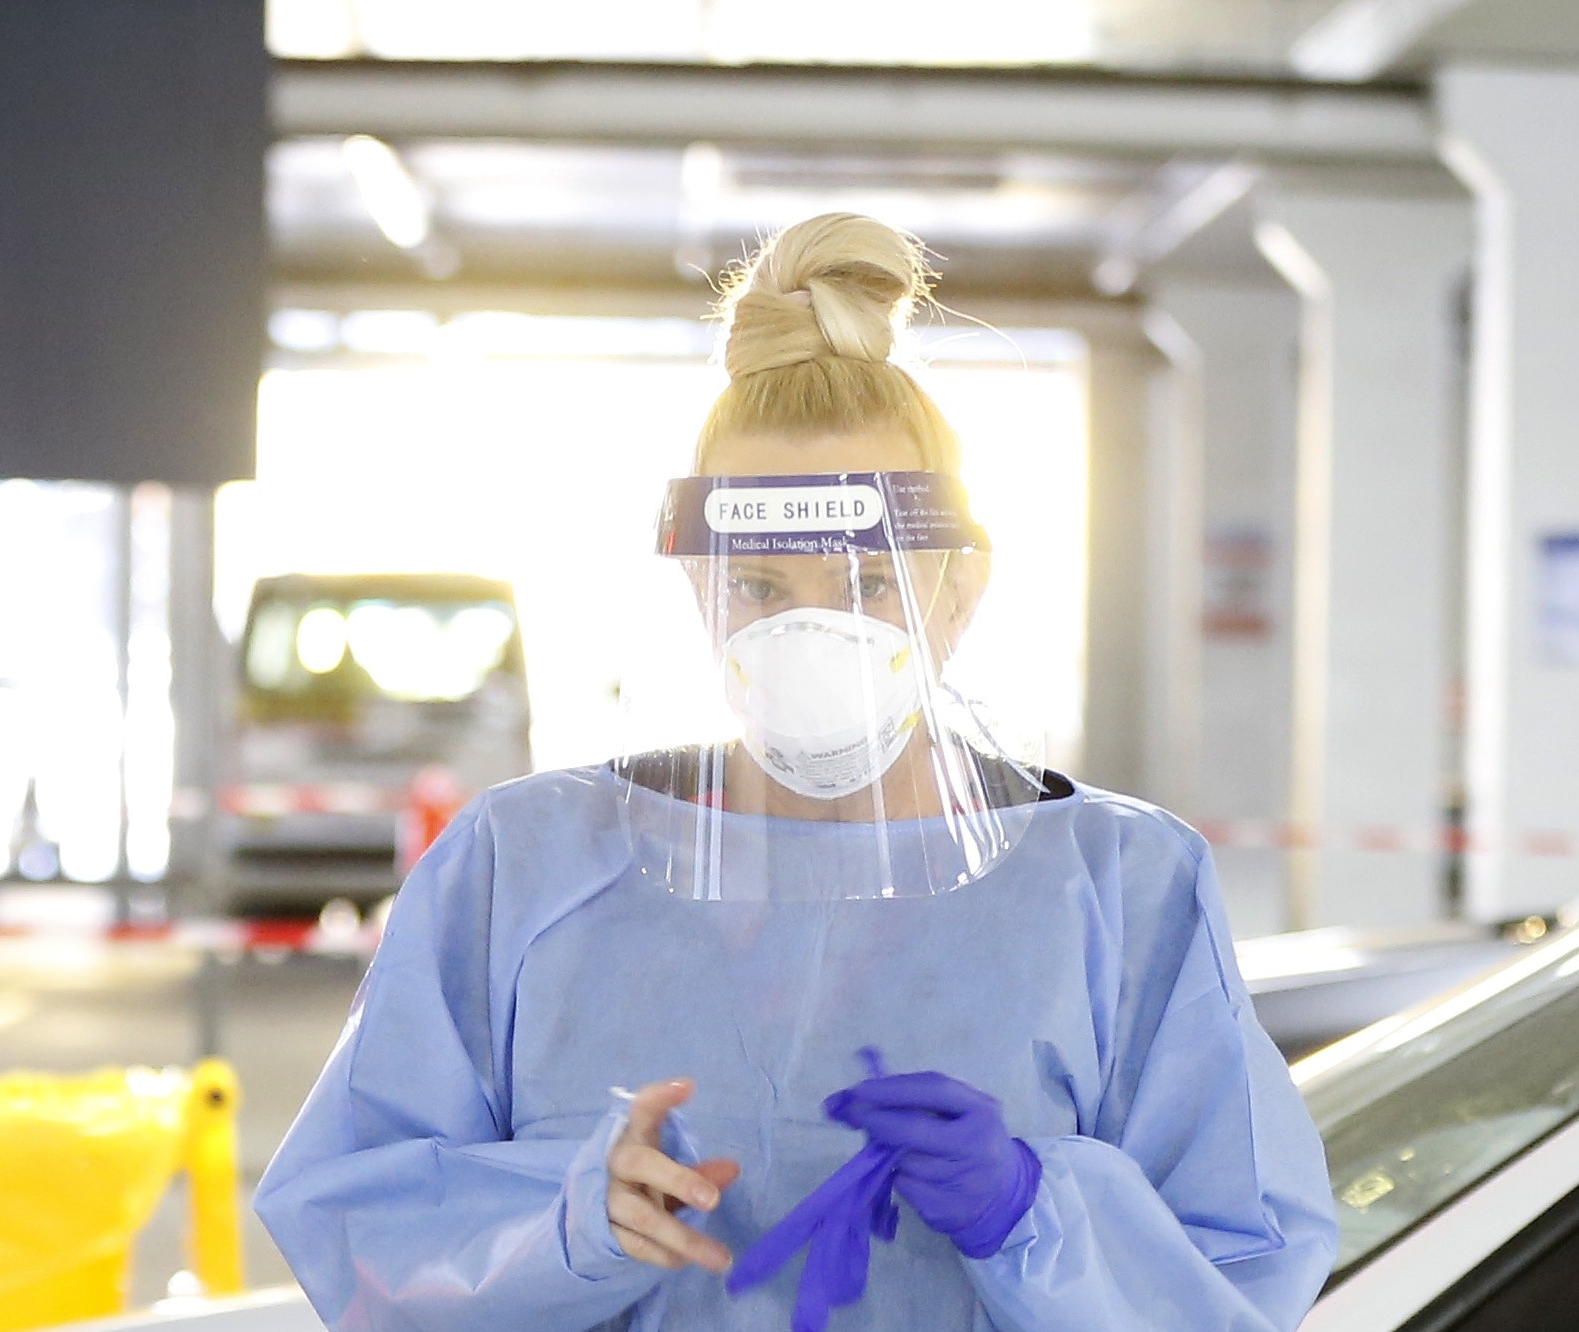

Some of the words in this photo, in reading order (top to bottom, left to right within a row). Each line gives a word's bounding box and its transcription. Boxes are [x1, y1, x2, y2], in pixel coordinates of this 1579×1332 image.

[719, 502, 767, 520] FACE
[783, 500, 866, 519] SHIELD
[731, 538, 769, 551] Medical
[772, 536, 818, 551] Isolation
